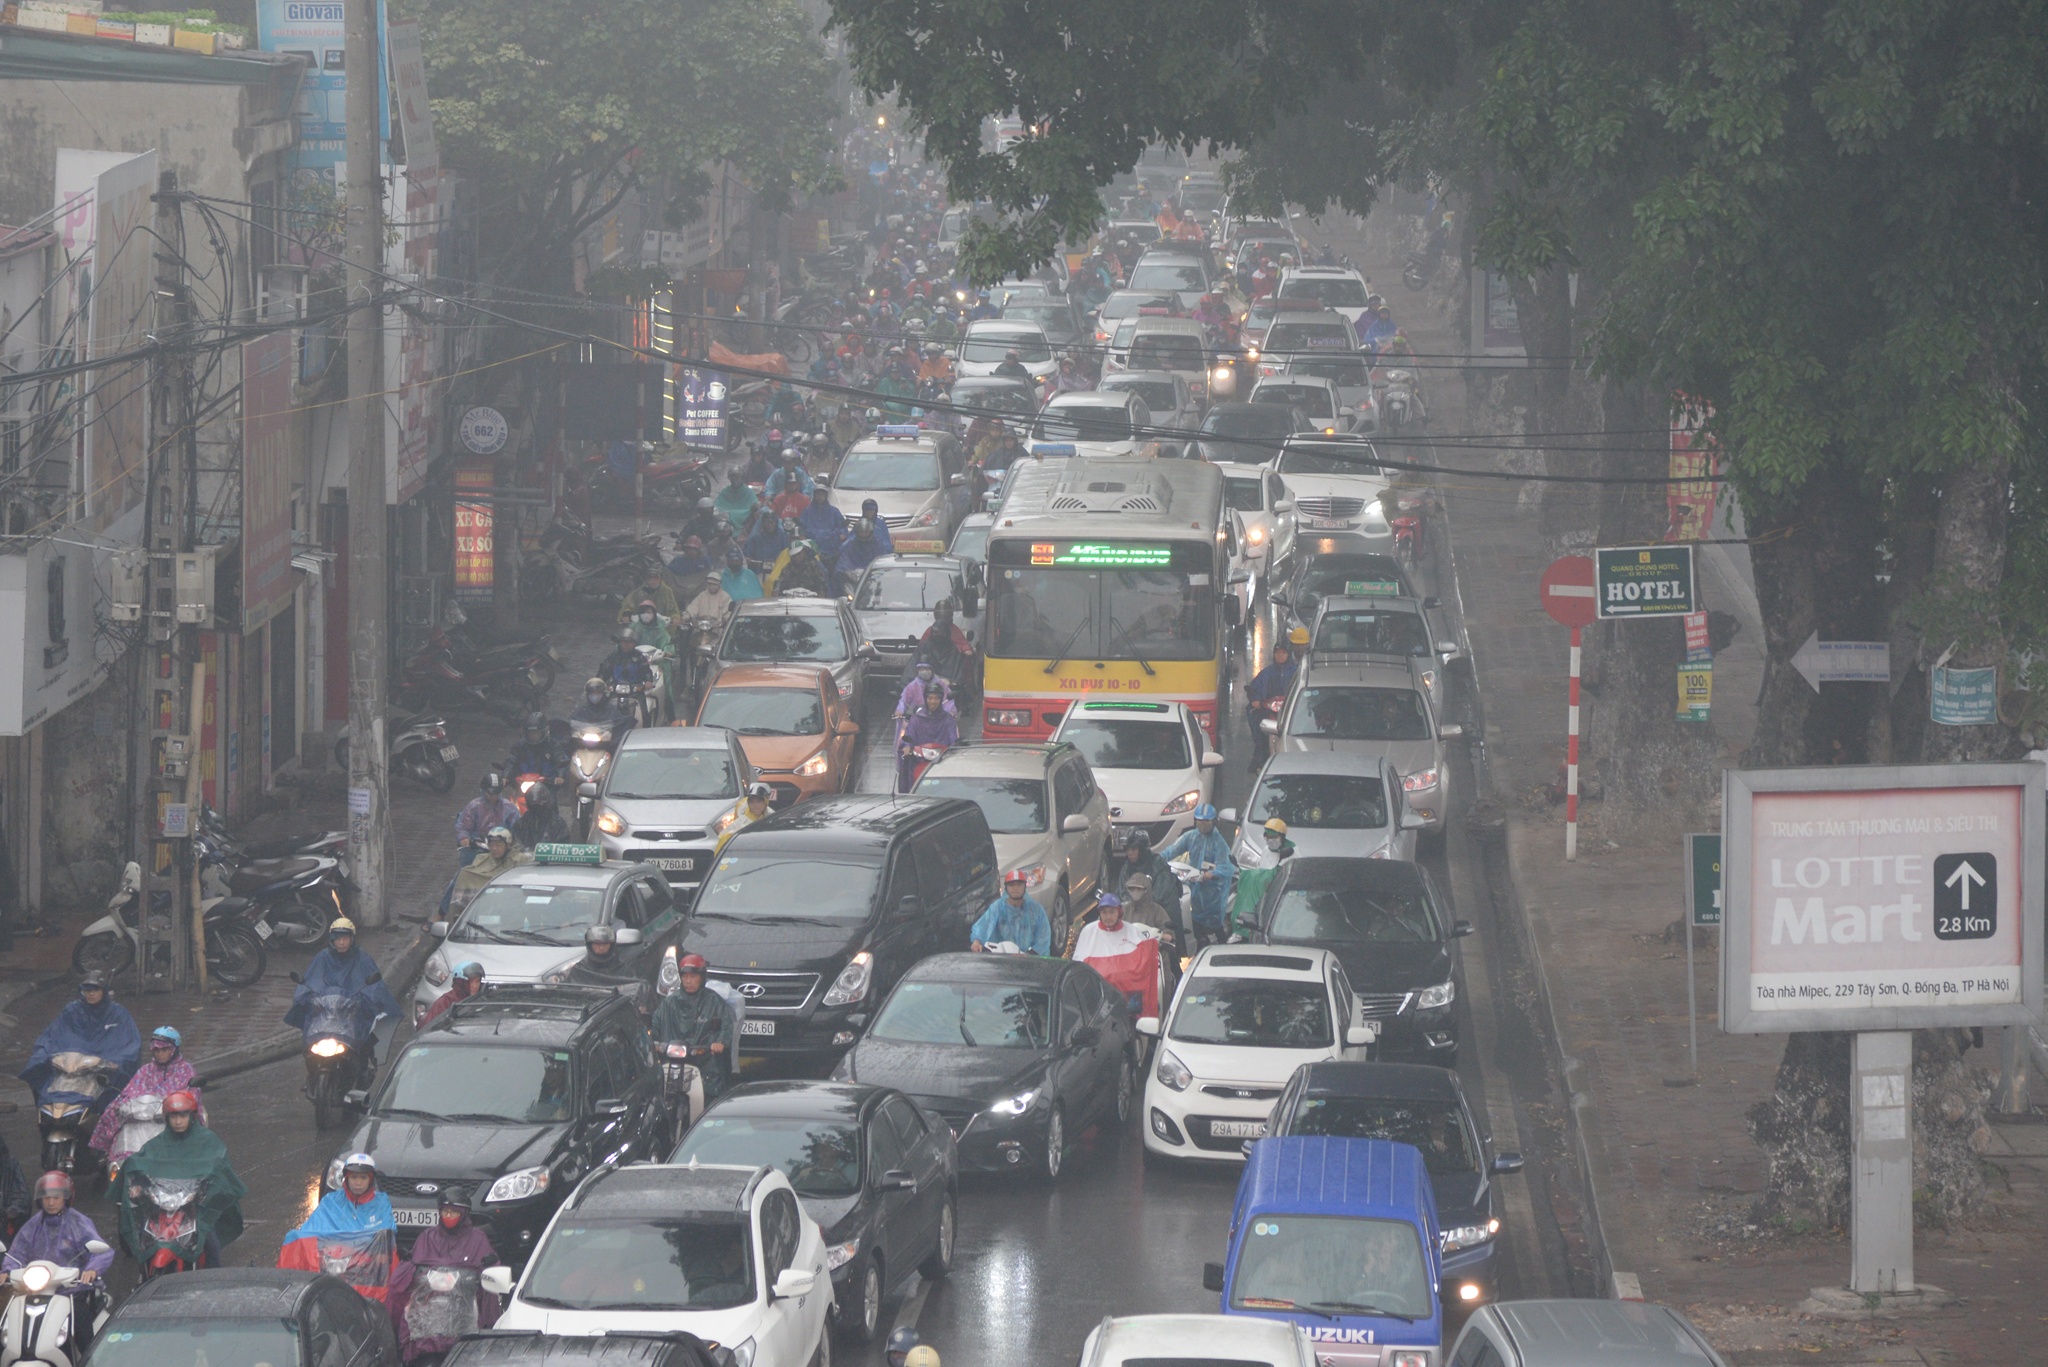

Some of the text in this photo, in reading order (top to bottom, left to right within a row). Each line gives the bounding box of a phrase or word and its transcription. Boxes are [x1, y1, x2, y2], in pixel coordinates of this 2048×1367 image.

[697, 410, 719, 418] COFFEE
[475, 426, 493, 437] 662
[701, 428, 718, 436] COFFEE
[456, 512, 472, 527] XE
[457, 530, 493, 552] XE SỐ
[1658, 563, 1679, 571] HOTEL
[1607, 580, 1685, 601] HOTEL
[1081, 678, 1104, 689] BUS
[1771, 821, 1813, 838] TRUNG
[1818, 817, 1845, 836] TÂM
[1850, 817, 1901, 836] THƯƠNG
[1934, 817, 1943, 833] &
[1947, 813, 1973, 833] SIÊU
[1771, 855, 1922, 889] LOTTE
[1771, 894, 1922, 946] Mart
[1939, 916, 1990, 933] 2.8 Km
[1757, 978, 2009, 1000] Tòa nhà Mipec, 229 Tây Sơn, Q. Đống Đa, TP Hà Nội
